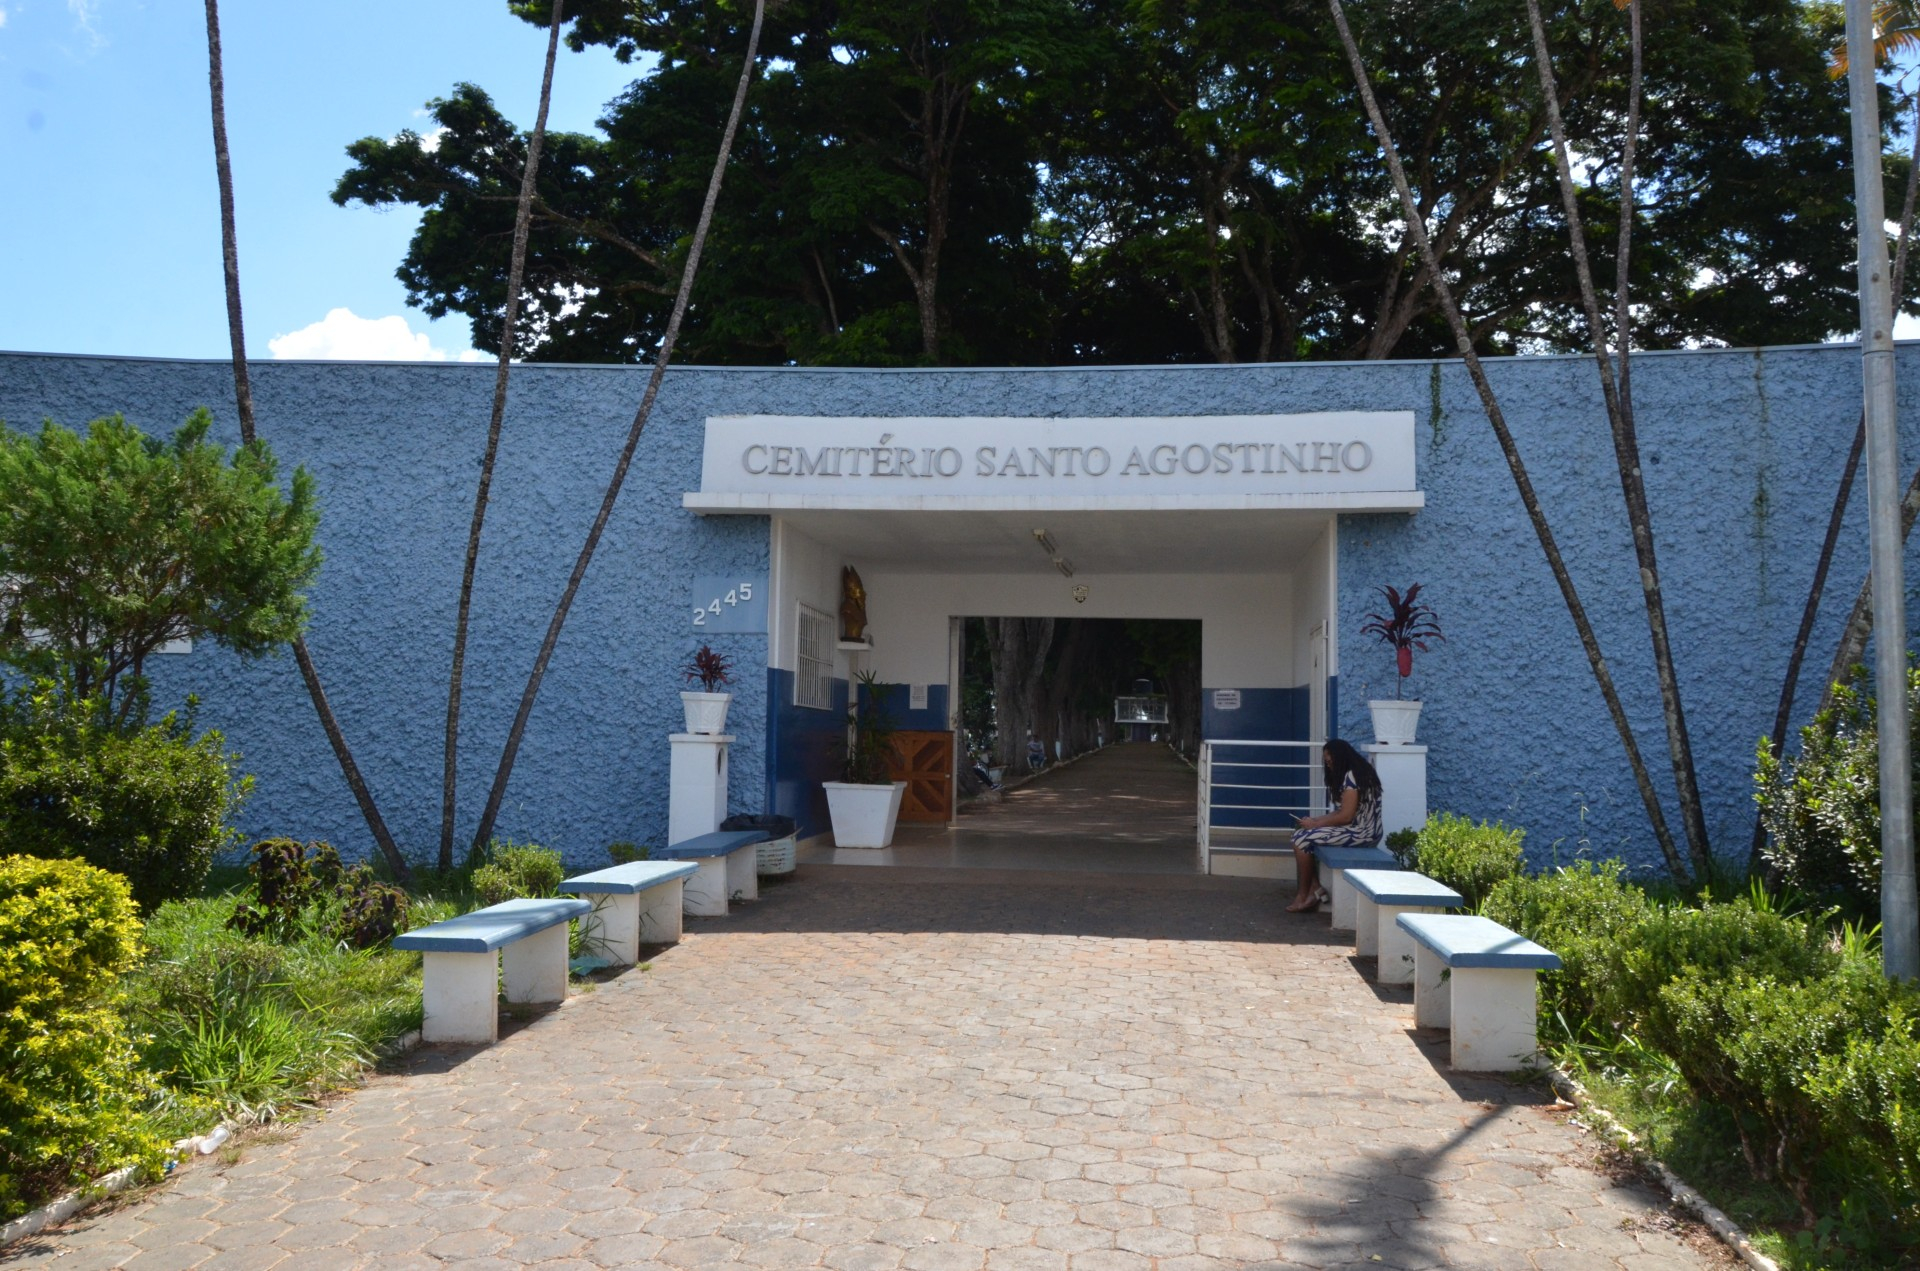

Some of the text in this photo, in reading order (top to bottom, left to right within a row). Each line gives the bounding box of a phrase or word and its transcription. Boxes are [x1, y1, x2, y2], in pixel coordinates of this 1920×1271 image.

[742, 433, 1374, 477] CEMITÉRIO SANTO AGOSTINHO
[693, 583, 752, 626] 2445
